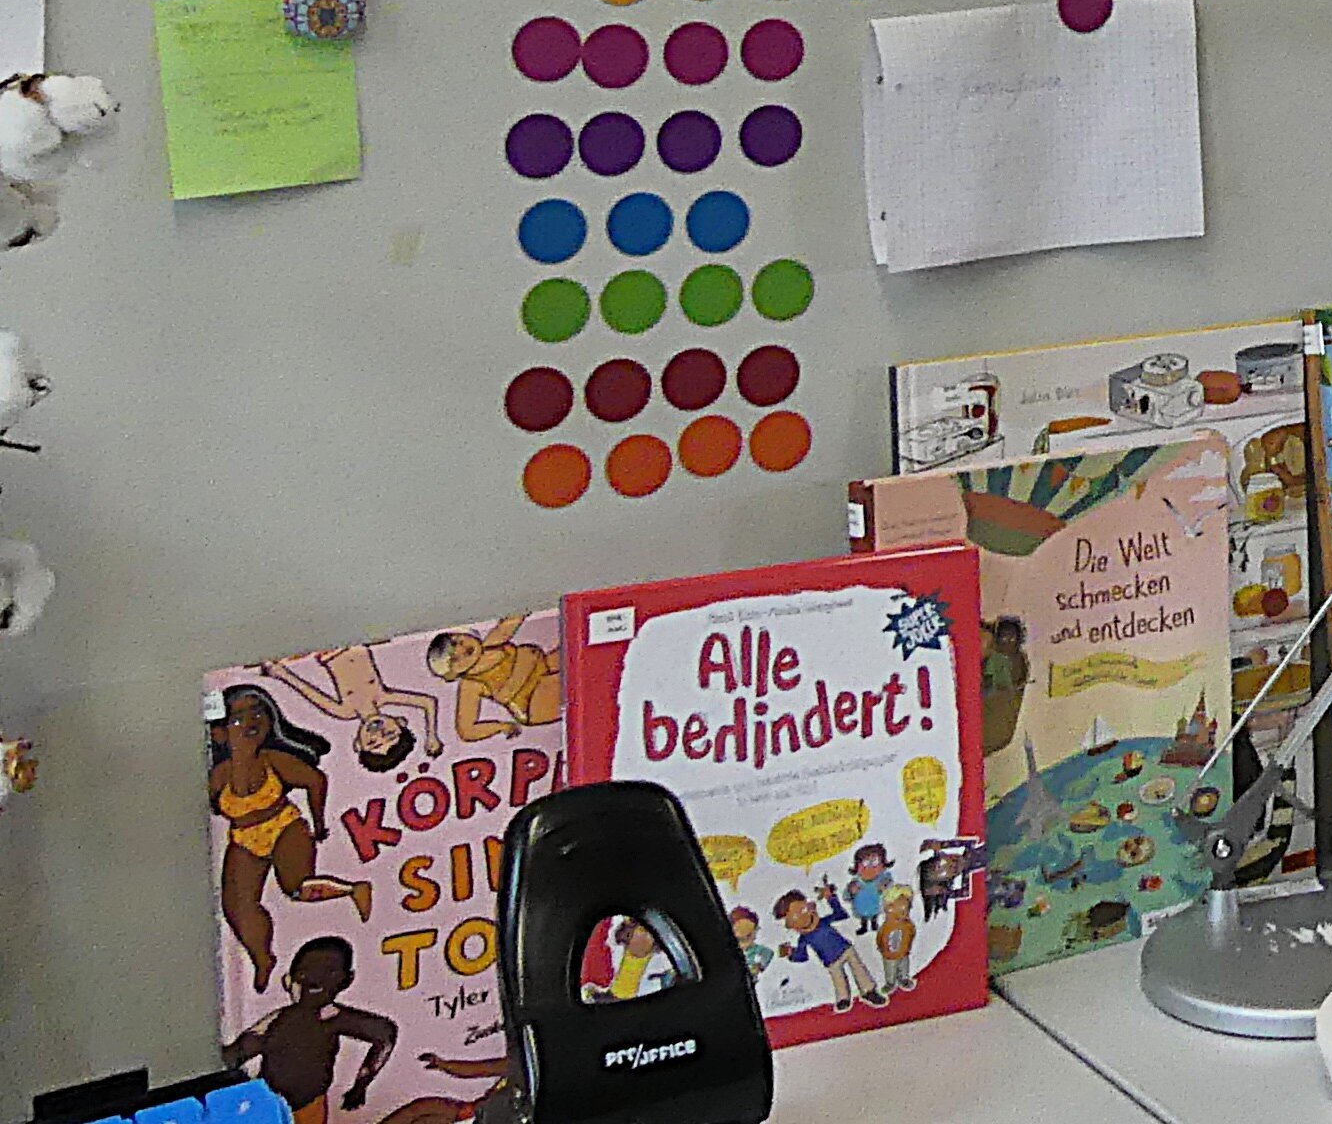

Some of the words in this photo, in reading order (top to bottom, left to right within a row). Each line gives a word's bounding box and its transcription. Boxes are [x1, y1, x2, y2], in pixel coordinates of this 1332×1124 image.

[1075, 537, 1108, 573] Die
[1119, 532, 1172, 567] Welt
[1056, 574, 1170, 610] schmecken
[1051, 619, 1082, 644] und
[1089, 606, 1195, 643] entdecken
[699, 624, 800, 697] Alle
[340, 748, 565, 864] KÖRP
[399, 835, 504, 913] SI
[381, 916, 498, 991] TO
[428, 986, 490, 1019] Tyler
